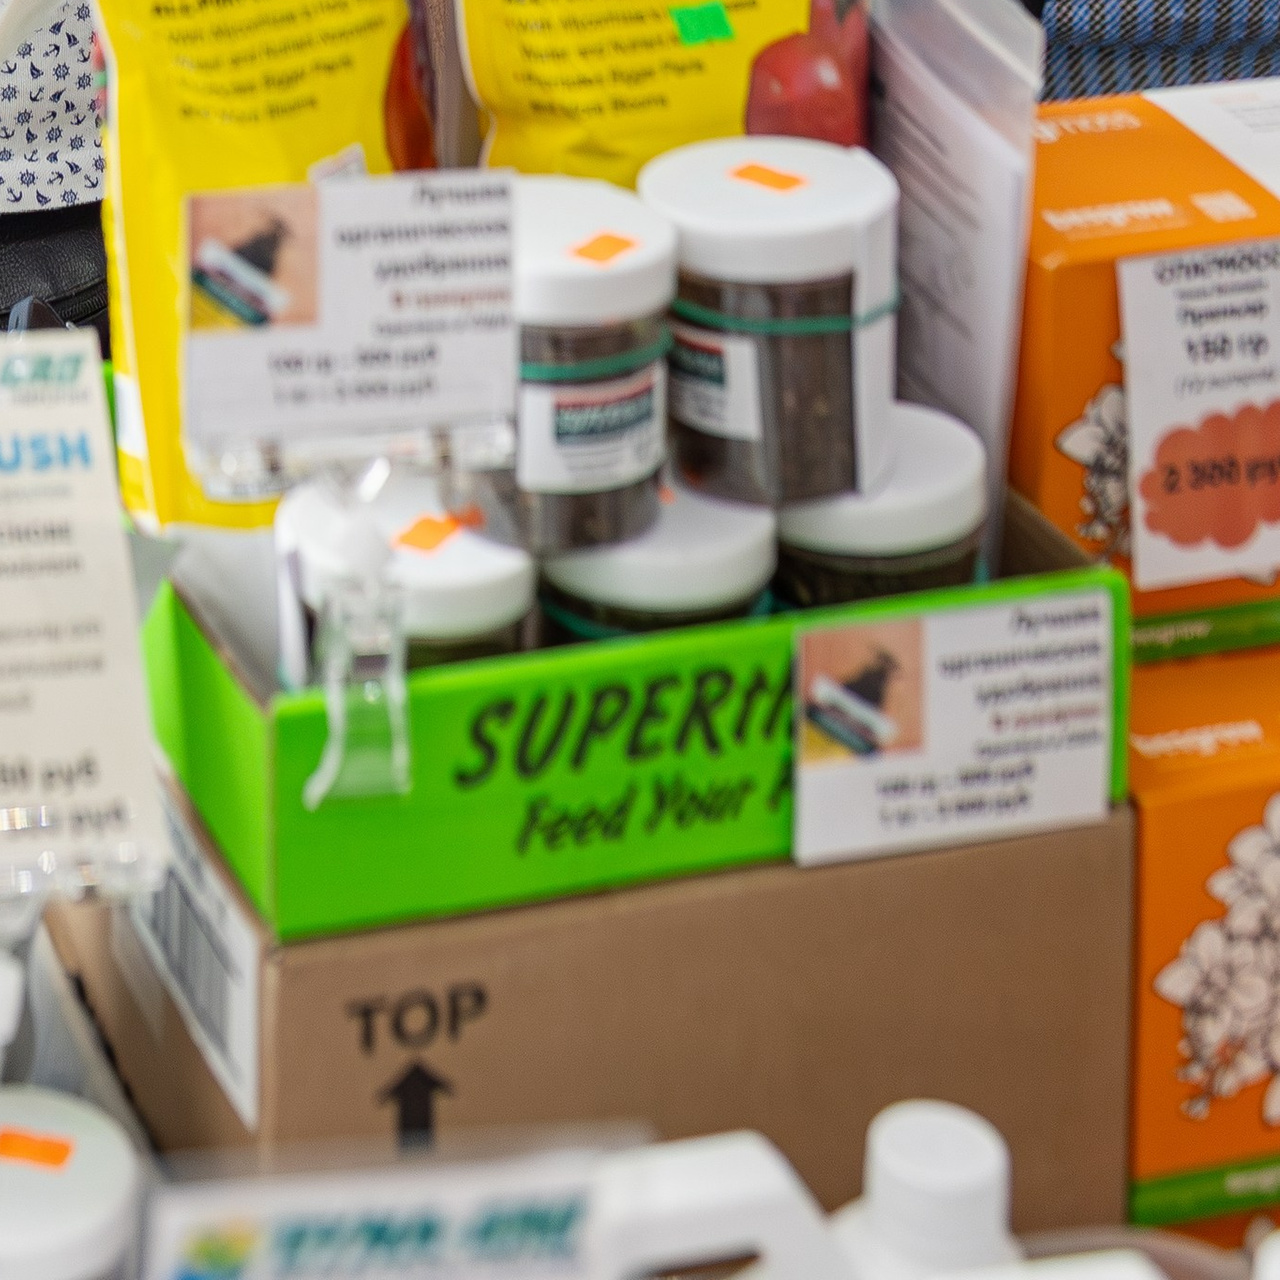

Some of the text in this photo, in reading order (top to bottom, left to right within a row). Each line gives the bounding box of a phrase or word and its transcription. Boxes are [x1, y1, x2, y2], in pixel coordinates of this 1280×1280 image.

[516, 779, 638, 857] Feed
[642, 772, 757, 835] Your
[346, 980, 490, 1057] TOP
